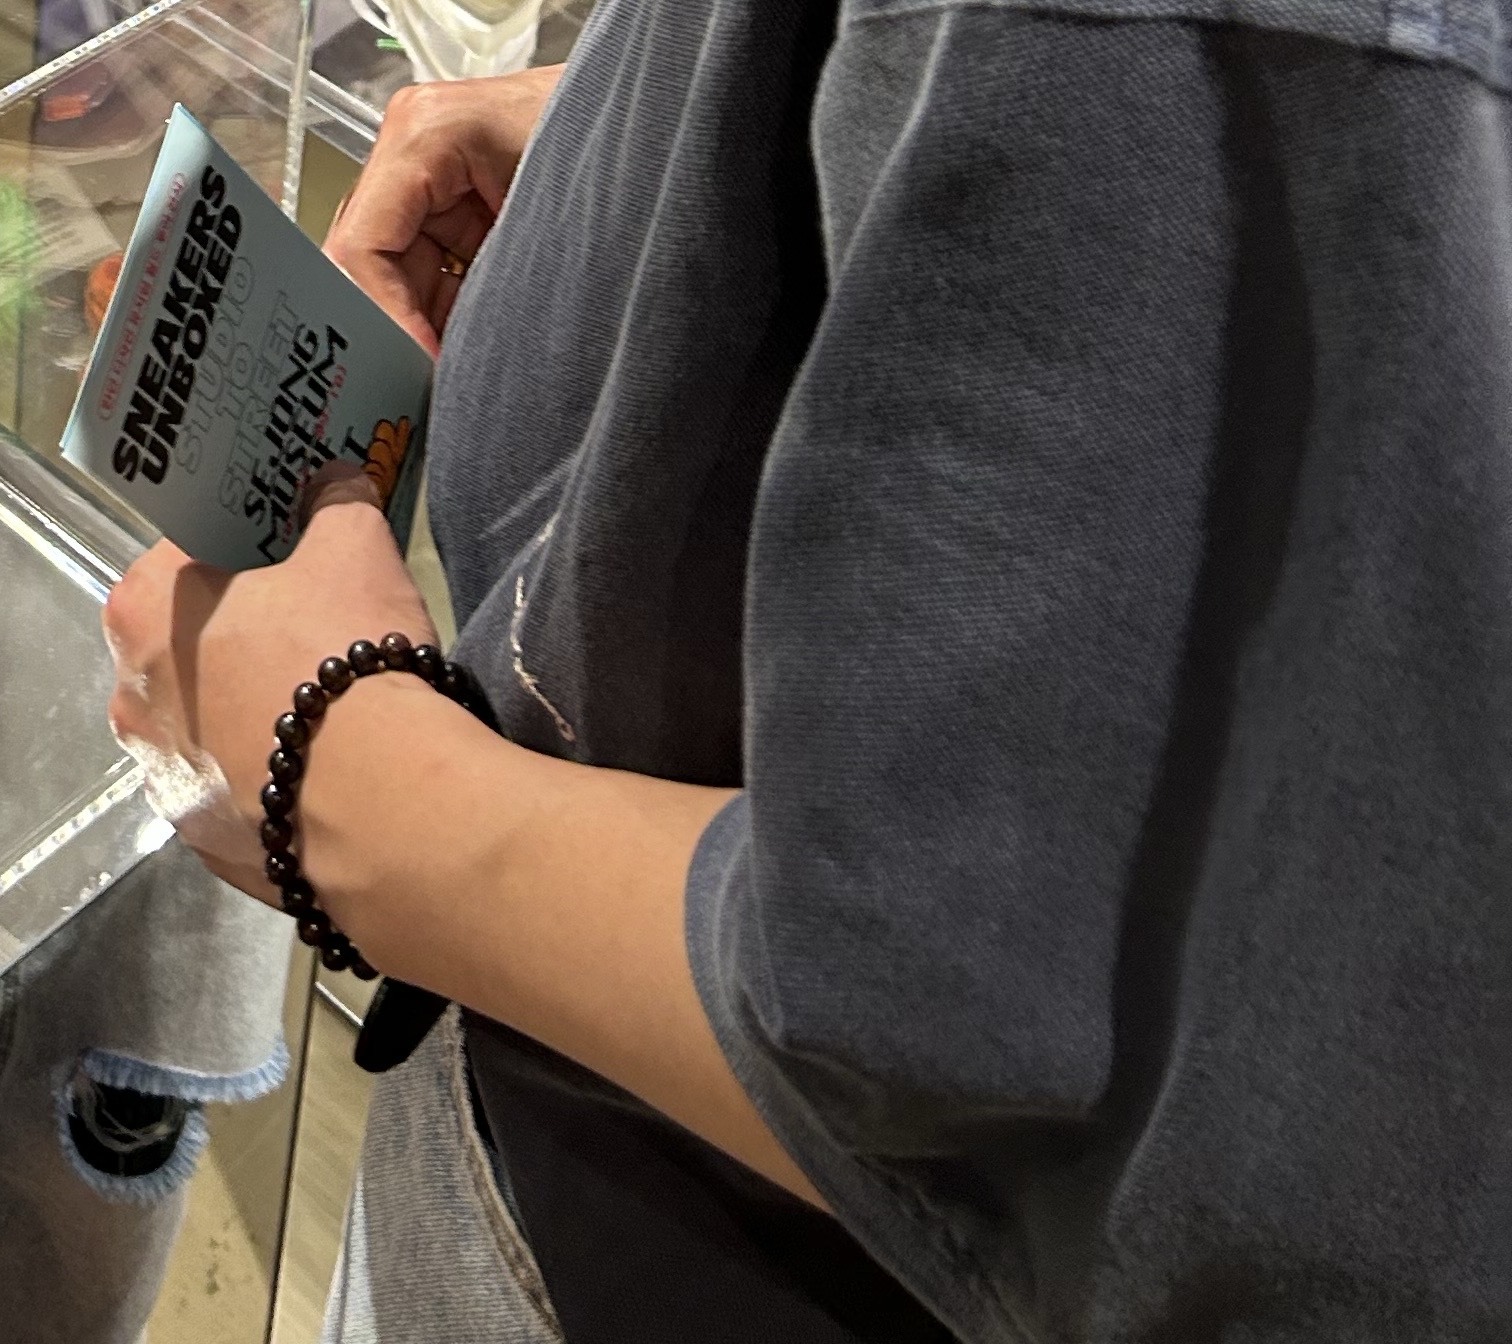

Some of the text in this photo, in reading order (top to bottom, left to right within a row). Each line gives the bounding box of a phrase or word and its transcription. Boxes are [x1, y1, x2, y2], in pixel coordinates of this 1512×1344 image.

[112, 165, 226, 483] SNEAKERS
[139, 204, 242, 486] UNBOXED
[174, 255, 255, 476] STUDIO
[257, 324, 349, 563] MUSEUM
